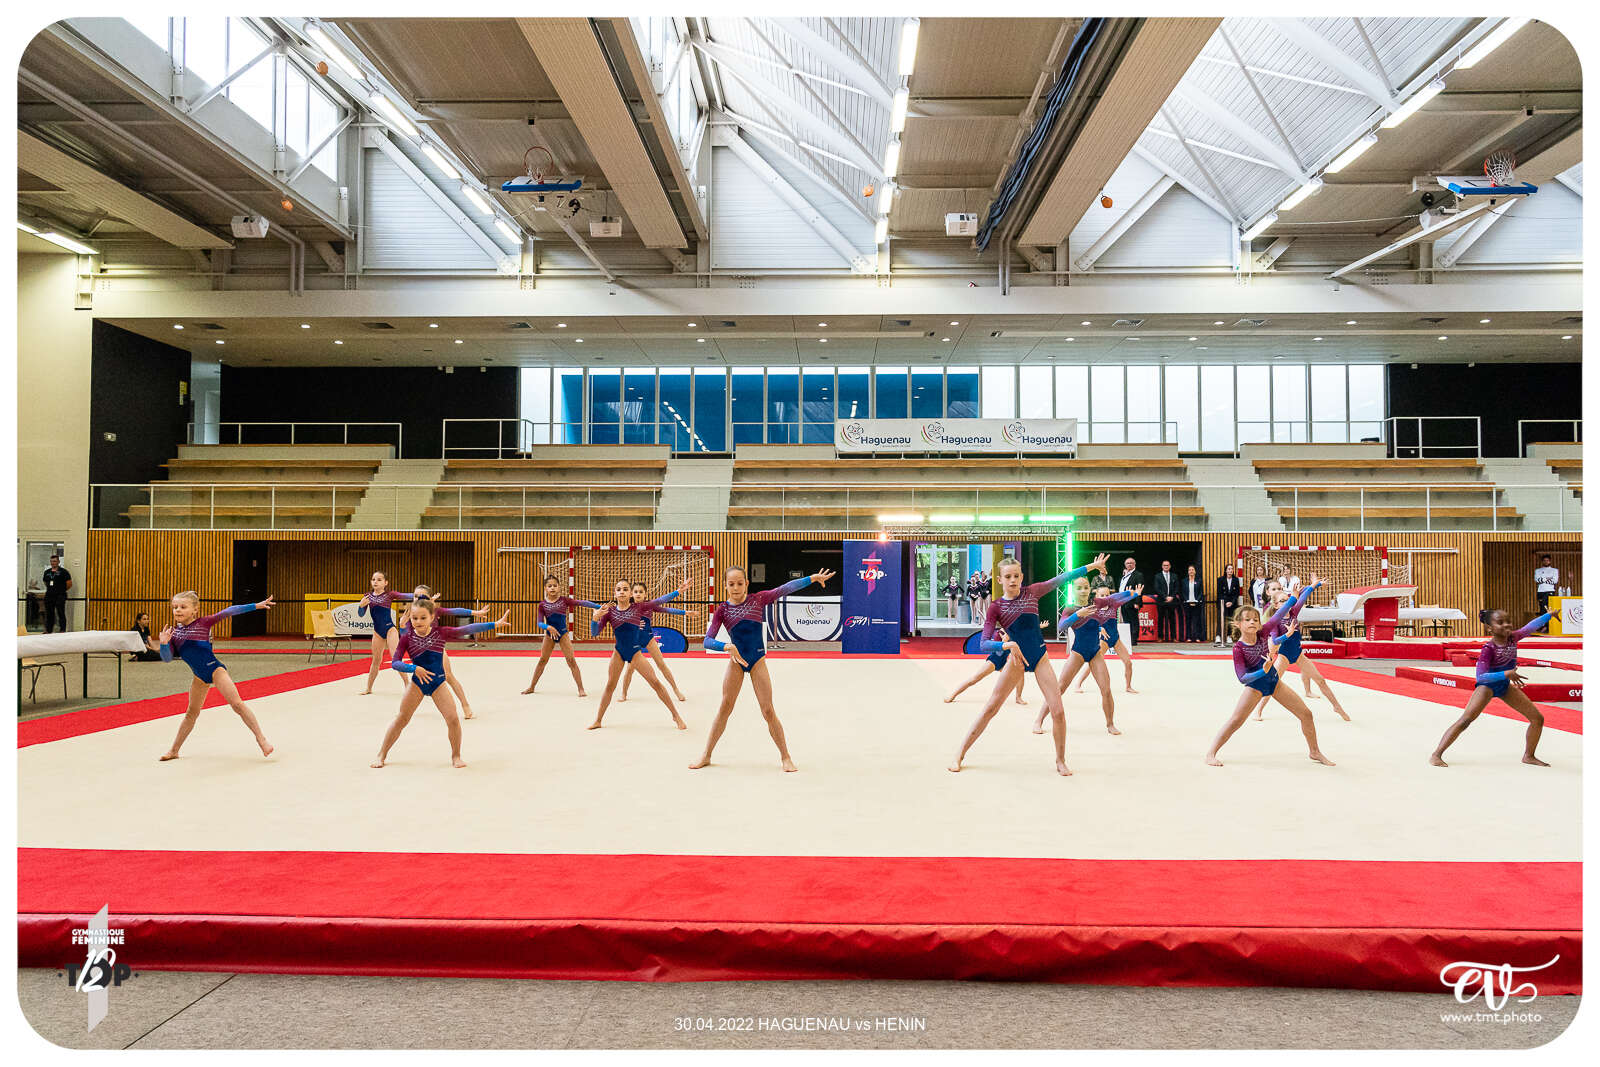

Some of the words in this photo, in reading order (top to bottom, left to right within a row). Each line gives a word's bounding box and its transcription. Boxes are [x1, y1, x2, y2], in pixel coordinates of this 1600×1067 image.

[861, 436, 911, 446] Haguenau
[941, 435, 992, 446] Haguenau
[1022, 435, 1073, 446] Haguenau
[1568, 689, 1583, 697] GY
